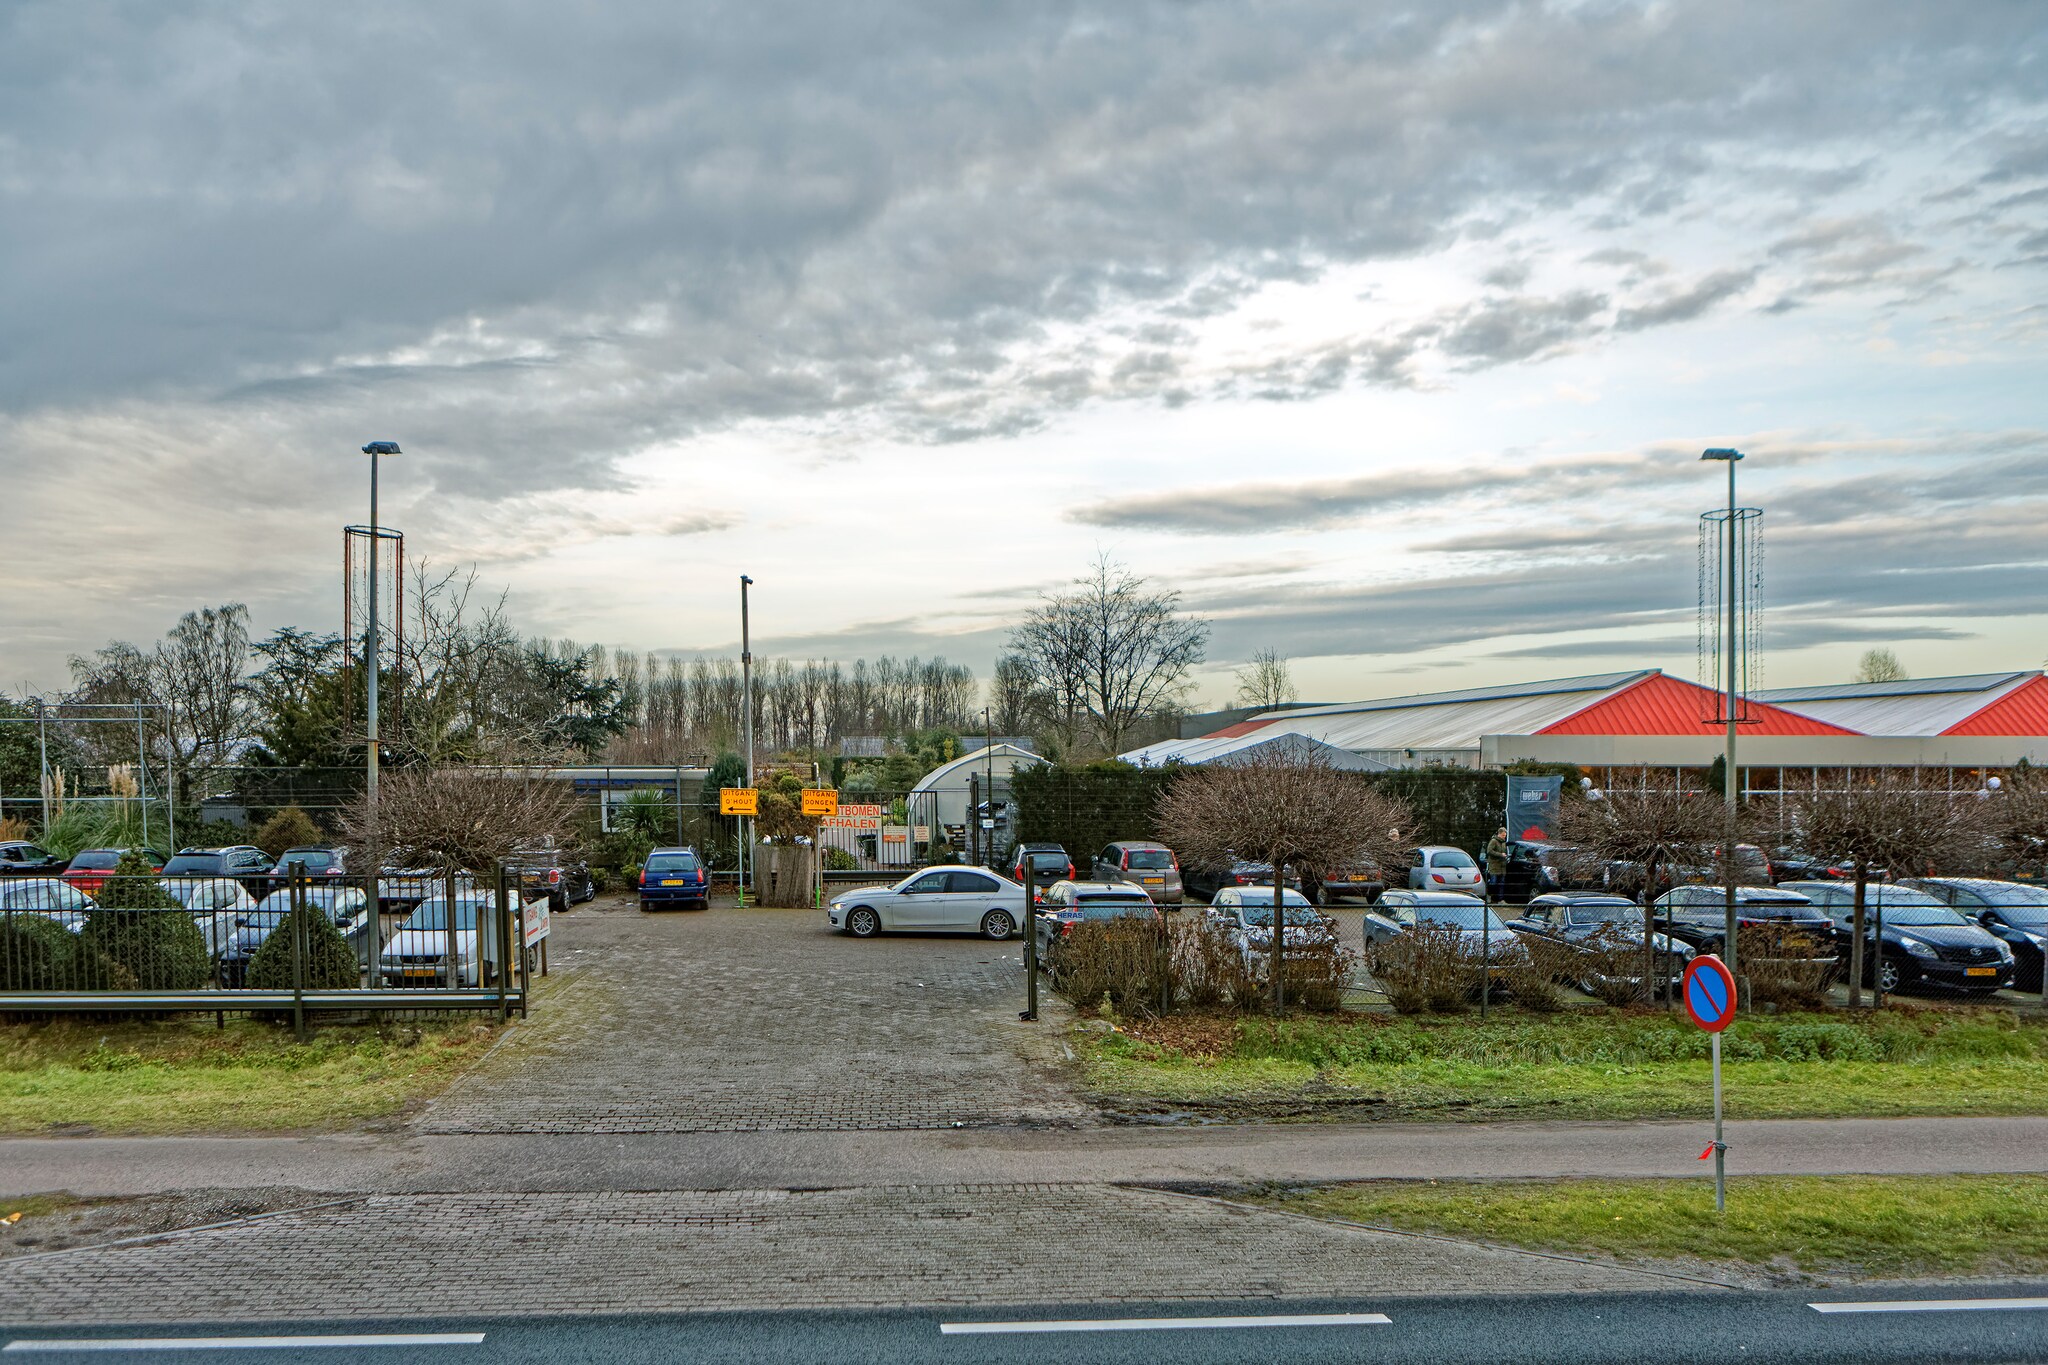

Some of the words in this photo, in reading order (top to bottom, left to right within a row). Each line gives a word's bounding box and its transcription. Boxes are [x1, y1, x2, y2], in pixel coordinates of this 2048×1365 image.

[722, 789, 756, 797] UITGANG
[804, 790, 836, 798] UITGANG
[837, 805, 880, 817] TBOMEN
[821, 818, 877, 829] AFHALEN
